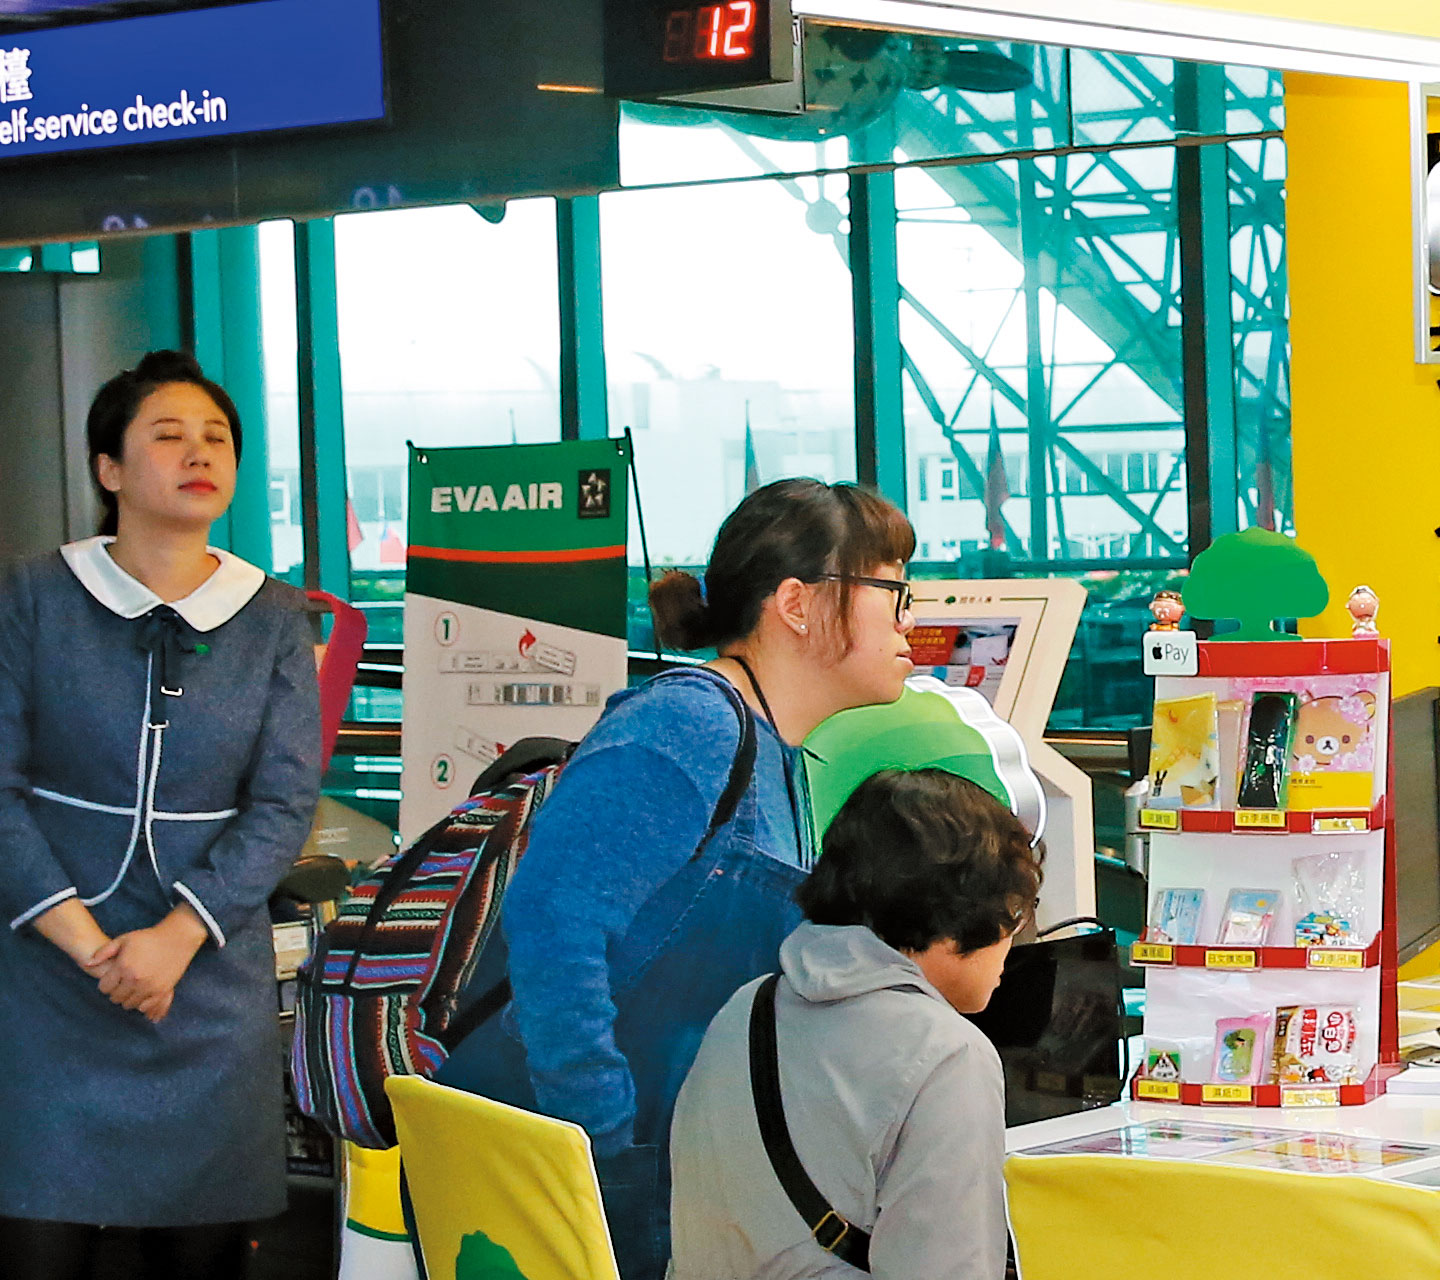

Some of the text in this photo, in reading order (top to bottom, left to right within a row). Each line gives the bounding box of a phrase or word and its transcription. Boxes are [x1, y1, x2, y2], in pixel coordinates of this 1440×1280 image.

[709, 0, 753, 58] 12
[123, 89, 227, 130] check-in
[430, 482, 563, 513] EVA AIR
[442, 618, 450, 640] 1
[1165, 643, 1190, 665] Pay
[437, 760, 449, 782] 2
